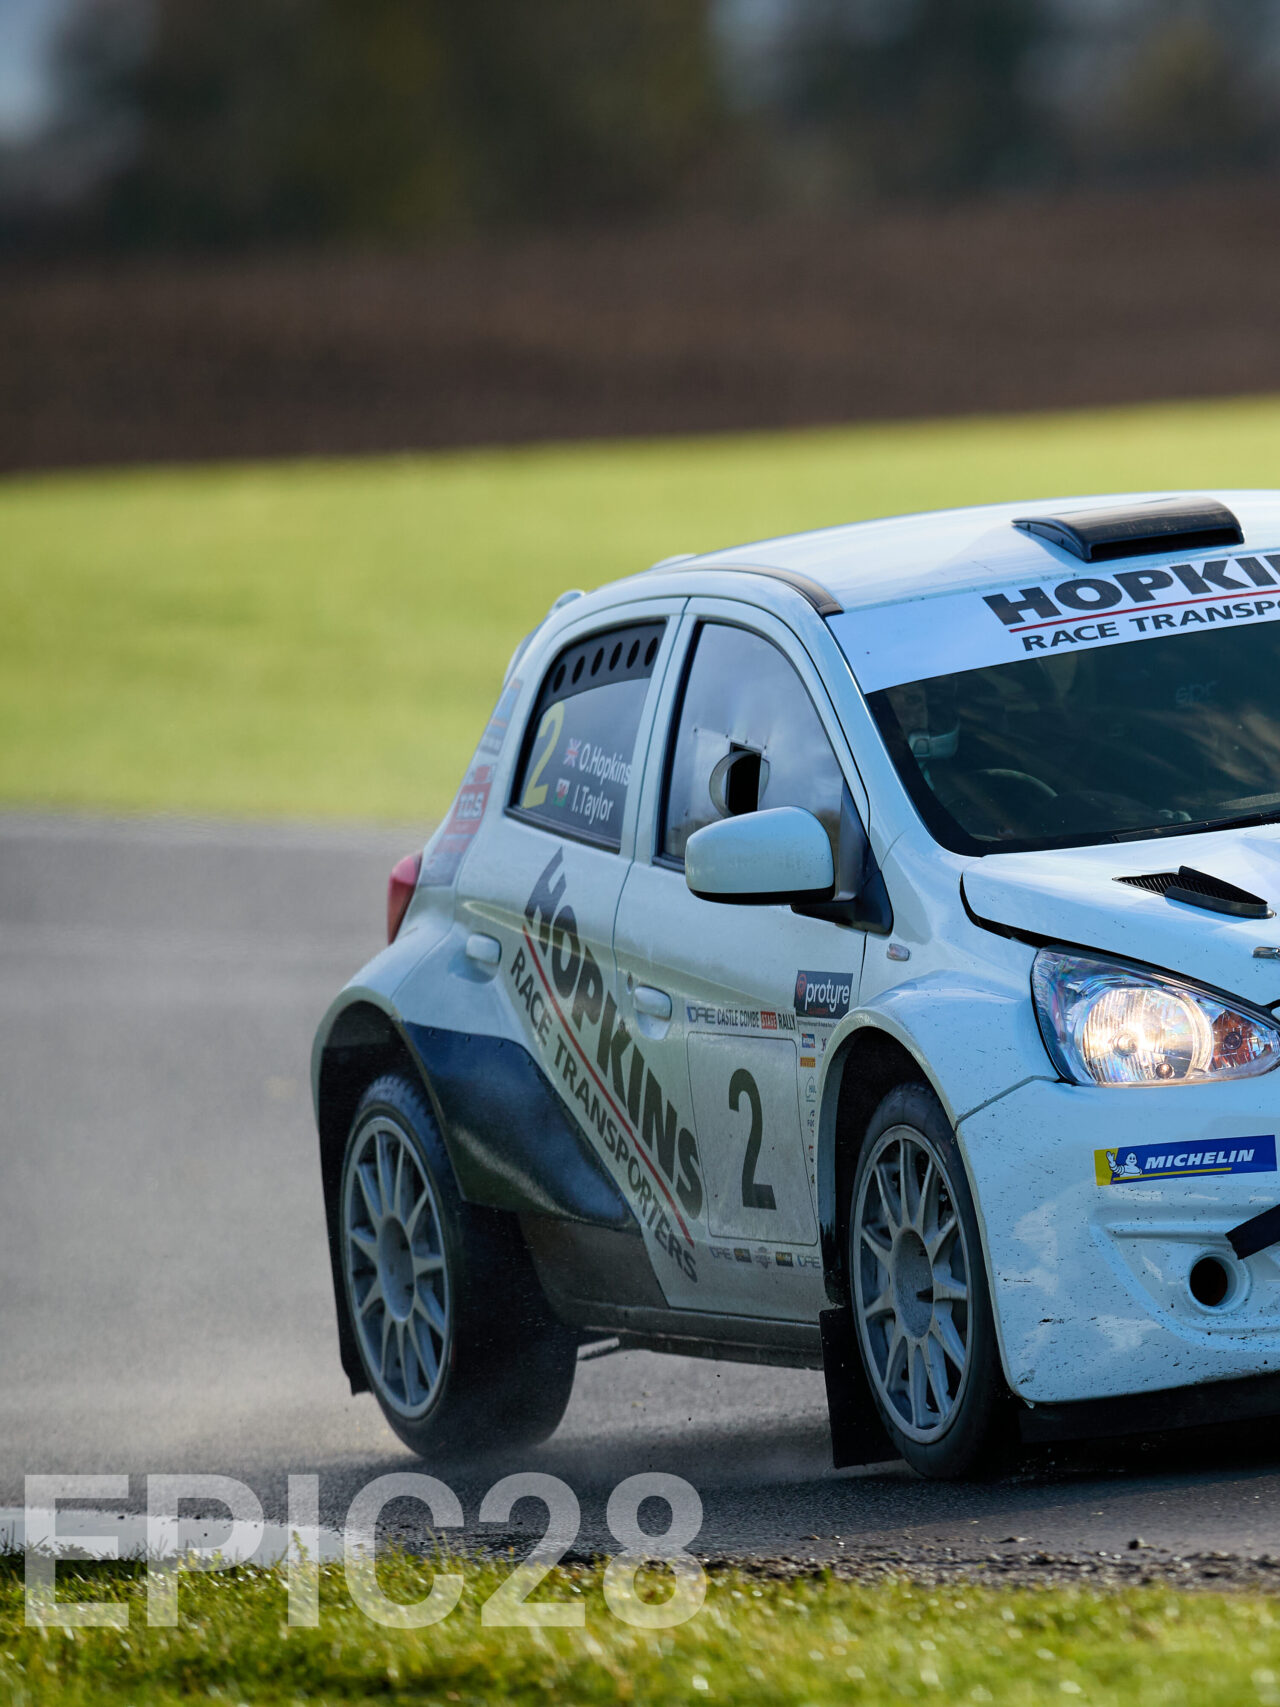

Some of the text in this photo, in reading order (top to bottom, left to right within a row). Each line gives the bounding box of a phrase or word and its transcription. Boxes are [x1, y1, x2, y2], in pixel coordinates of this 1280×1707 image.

[1021, 621, 1120, 652] RACE
[521, 701, 565, 809] 2
[579, 743, 632, 786] O.Hopkins
[571, 784, 613, 825] I.Taylor
[804, 979, 850, 1013] protyre
[524, 846, 703, 1220] HOPKINS
[717, 1008, 738, 1027] CASTLE
[740, 1011, 760, 1028] COMBE
[762, 1013, 777, 1028] STAGE
[778, 1013, 796, 1030] RALLY
[510, 947, 698, 1283] RACE TRANSPORTERS
[729, 1068, 777, 1210] 2
[1145, 1149, 1255, 1170] MICHELIN
